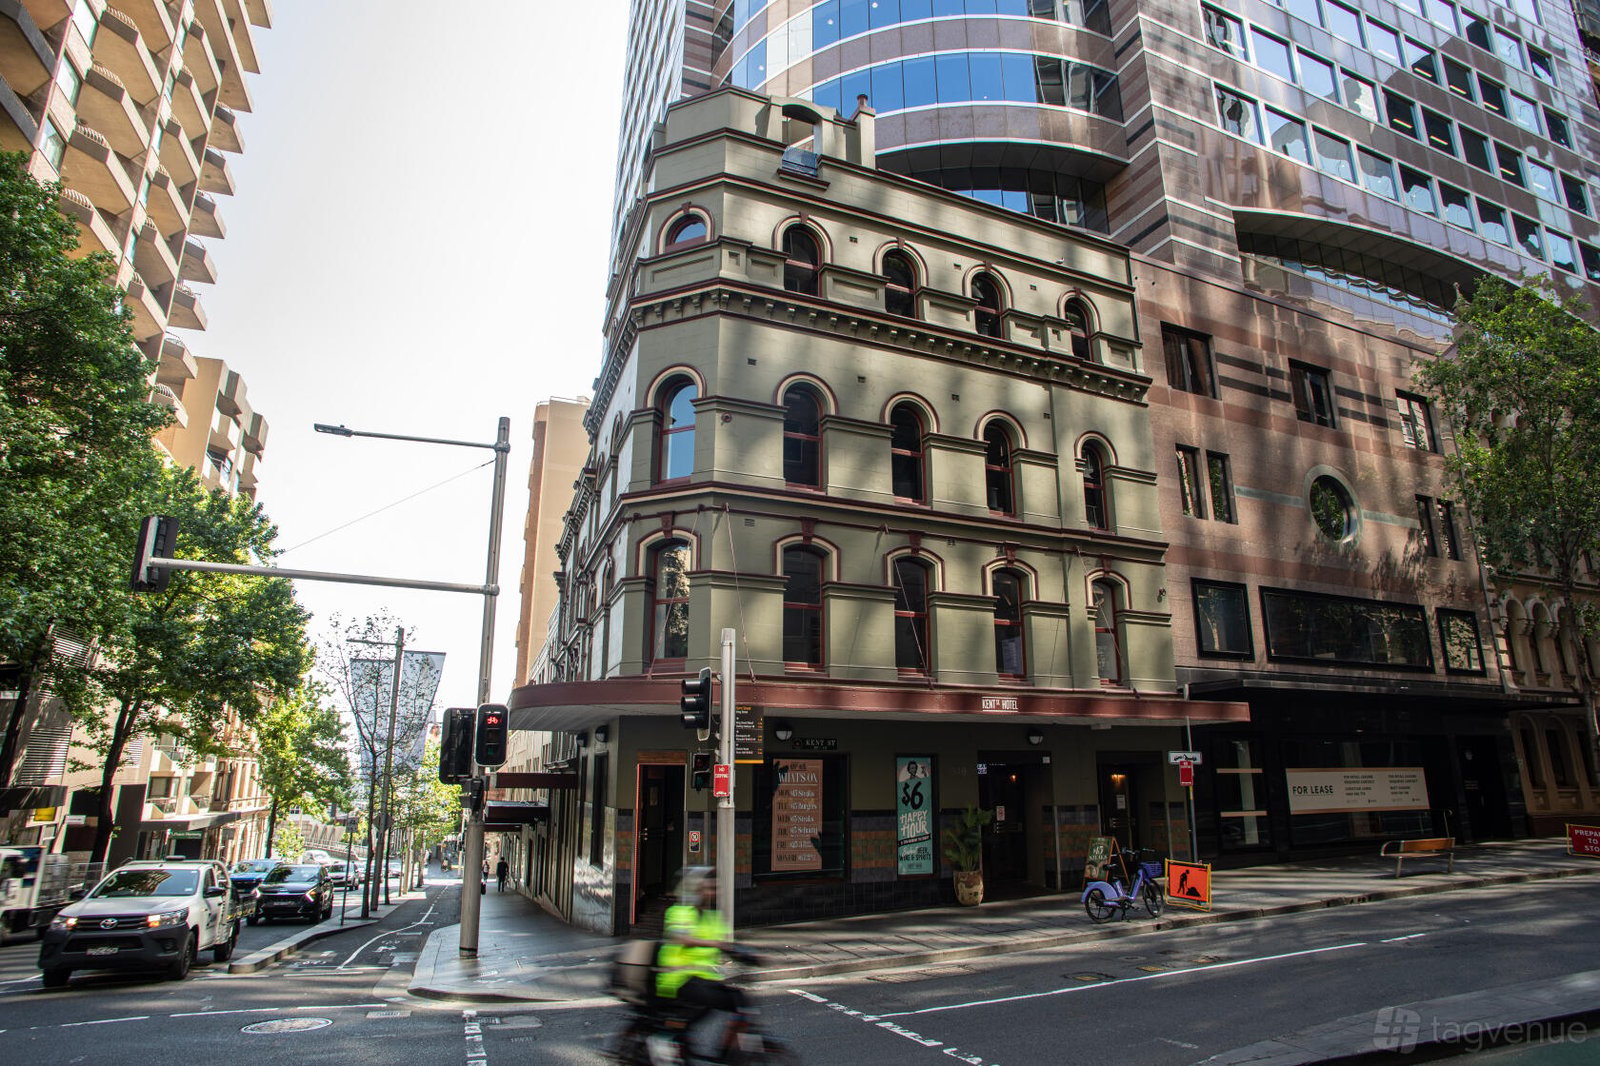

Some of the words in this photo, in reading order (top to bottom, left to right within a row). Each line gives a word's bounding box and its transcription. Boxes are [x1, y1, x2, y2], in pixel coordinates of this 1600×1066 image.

[982, 699, 996, 709] KENT
[1001, 699, 1018, 710] HOTEL
[901, 781, 924, 810] $6
[1292, 785, 1308, 795] FOR
[1311, 785, 1334, 794] LEASE
[900, 810, 928, 824] HAPPY
[900, 820, 930, 838] HOUR
